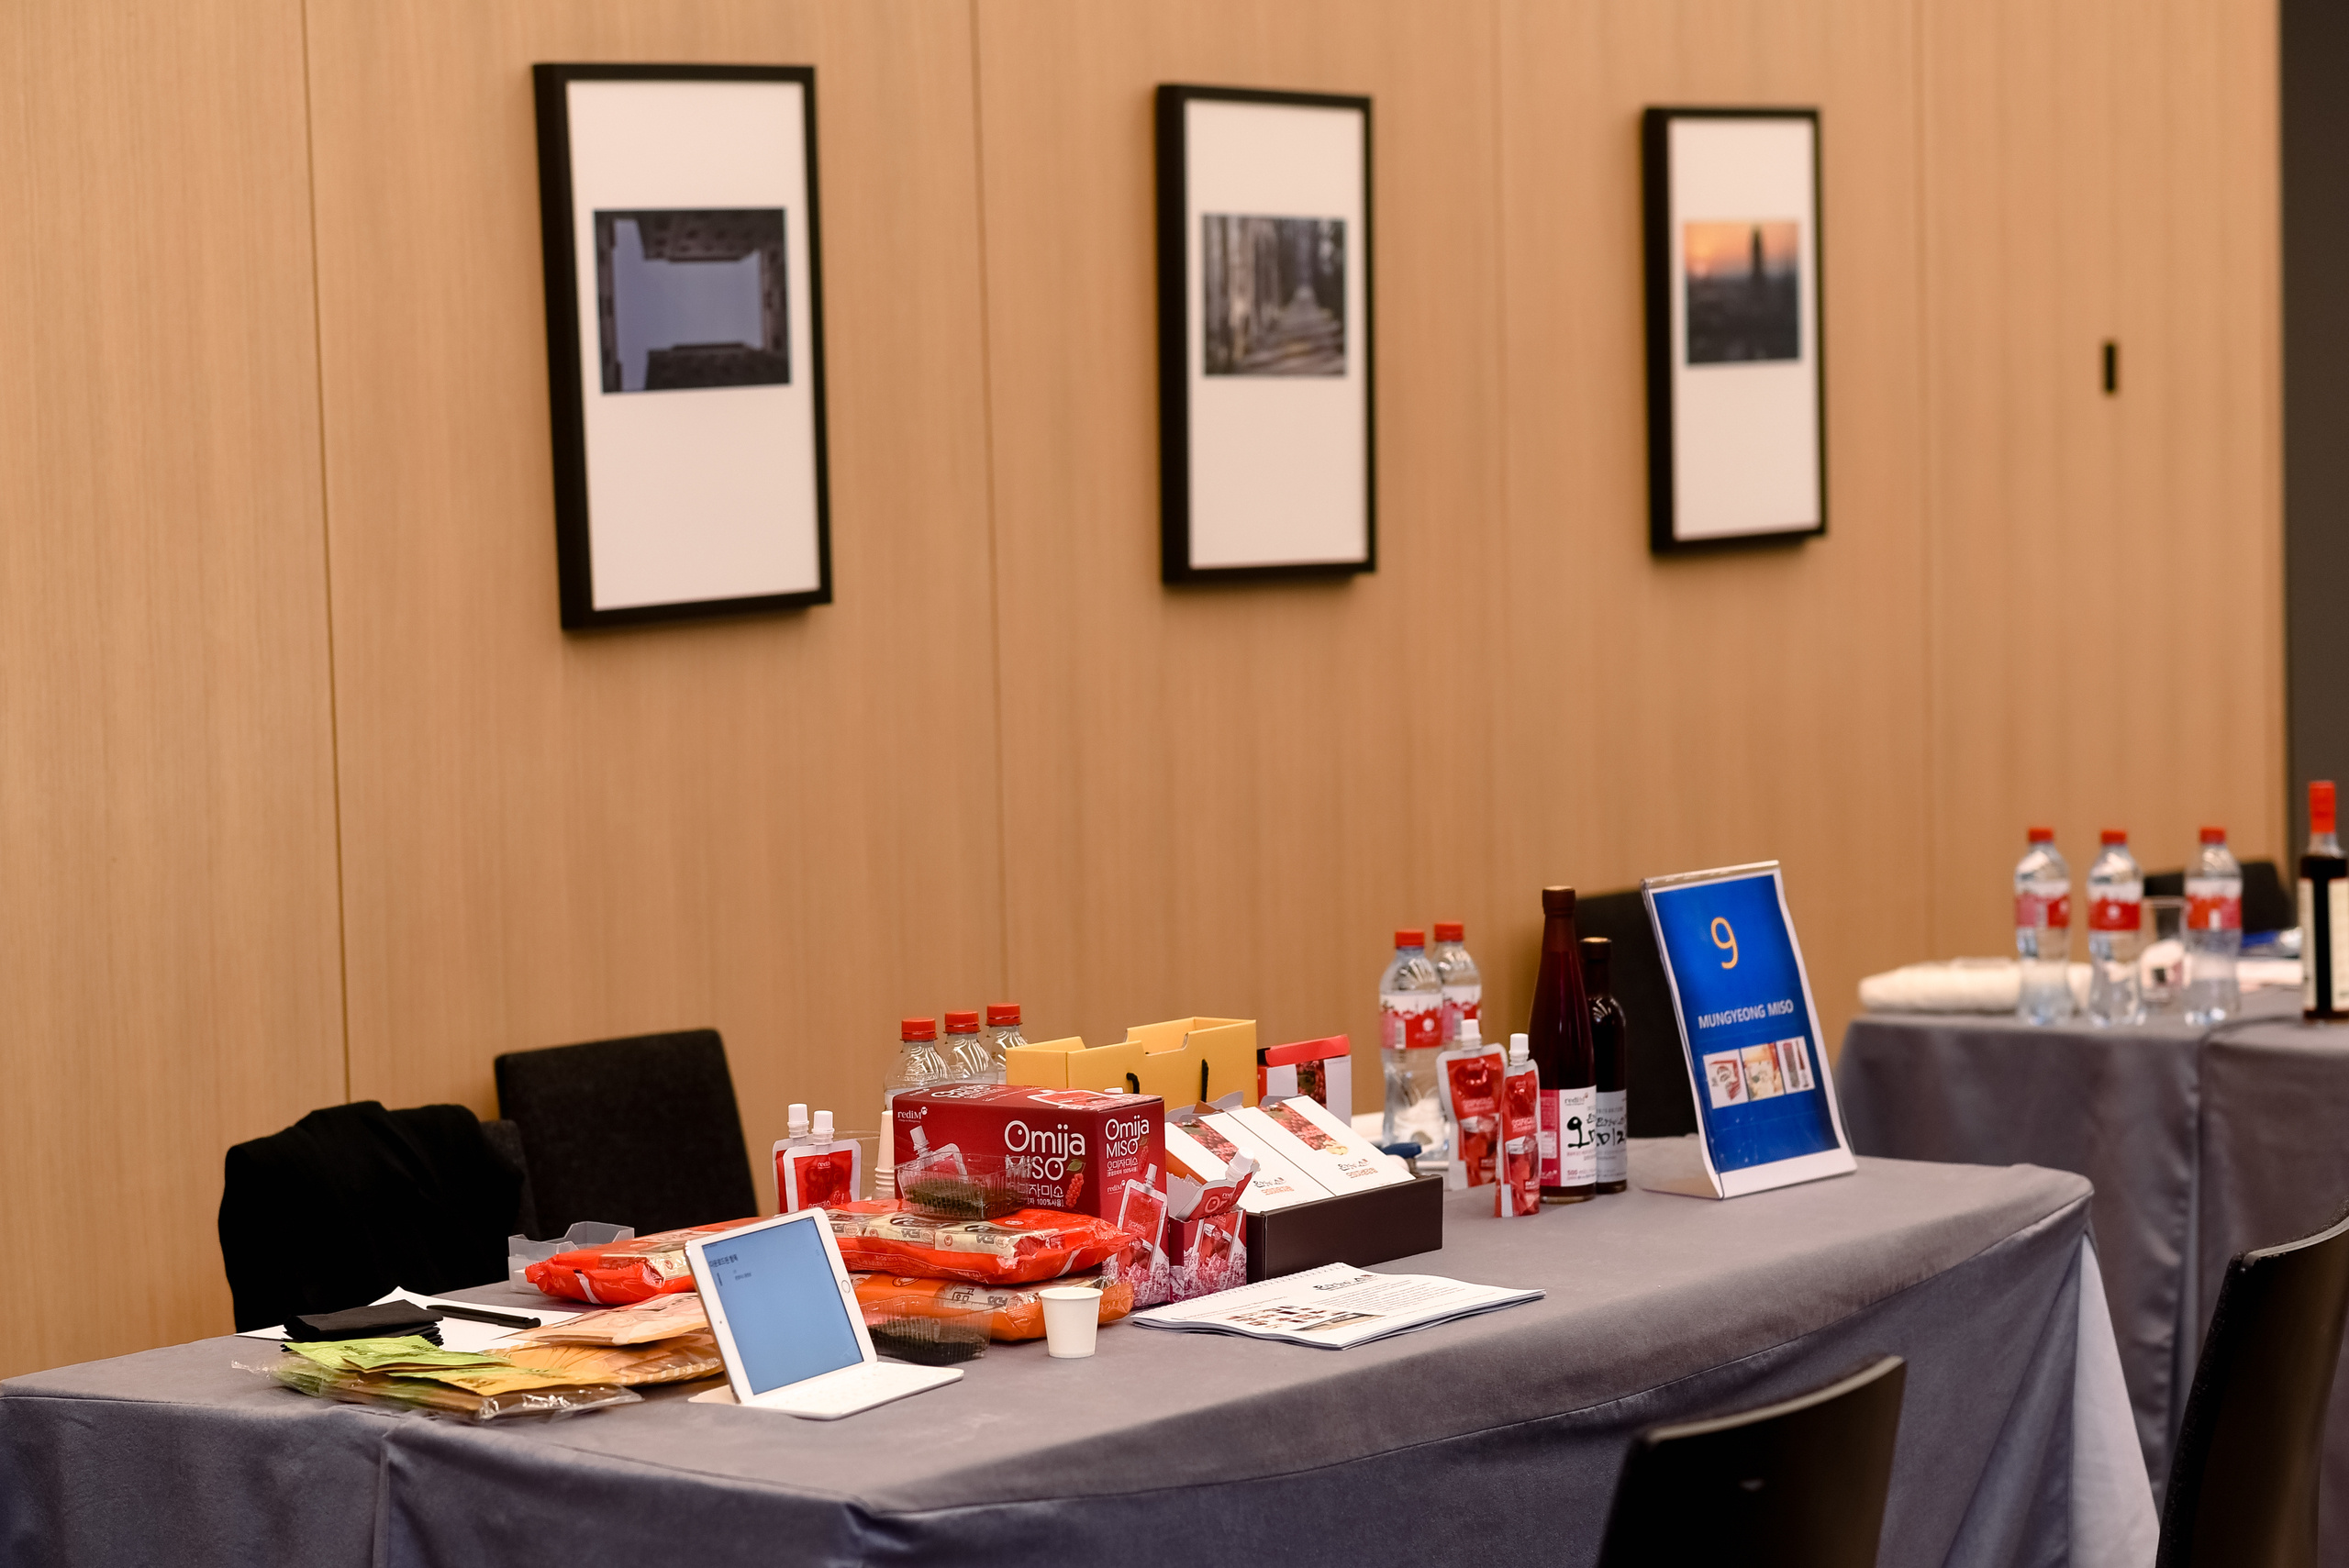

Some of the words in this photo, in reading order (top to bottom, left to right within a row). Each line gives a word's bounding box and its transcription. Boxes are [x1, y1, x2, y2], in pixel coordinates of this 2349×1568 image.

[1710, 916, 1739, 970] 9
[1698, 1004, 1765, 1029] MUNGYEONG
[1767, 999, 1794, 1017] MISO
[1004, 1119, 1085, 1159] Omija
[1105, 1115, 1150, 1140] Omija
[1106, 1139, 1139, 1159] MISO
[1005, 1154, 1064, 1181] MISO
